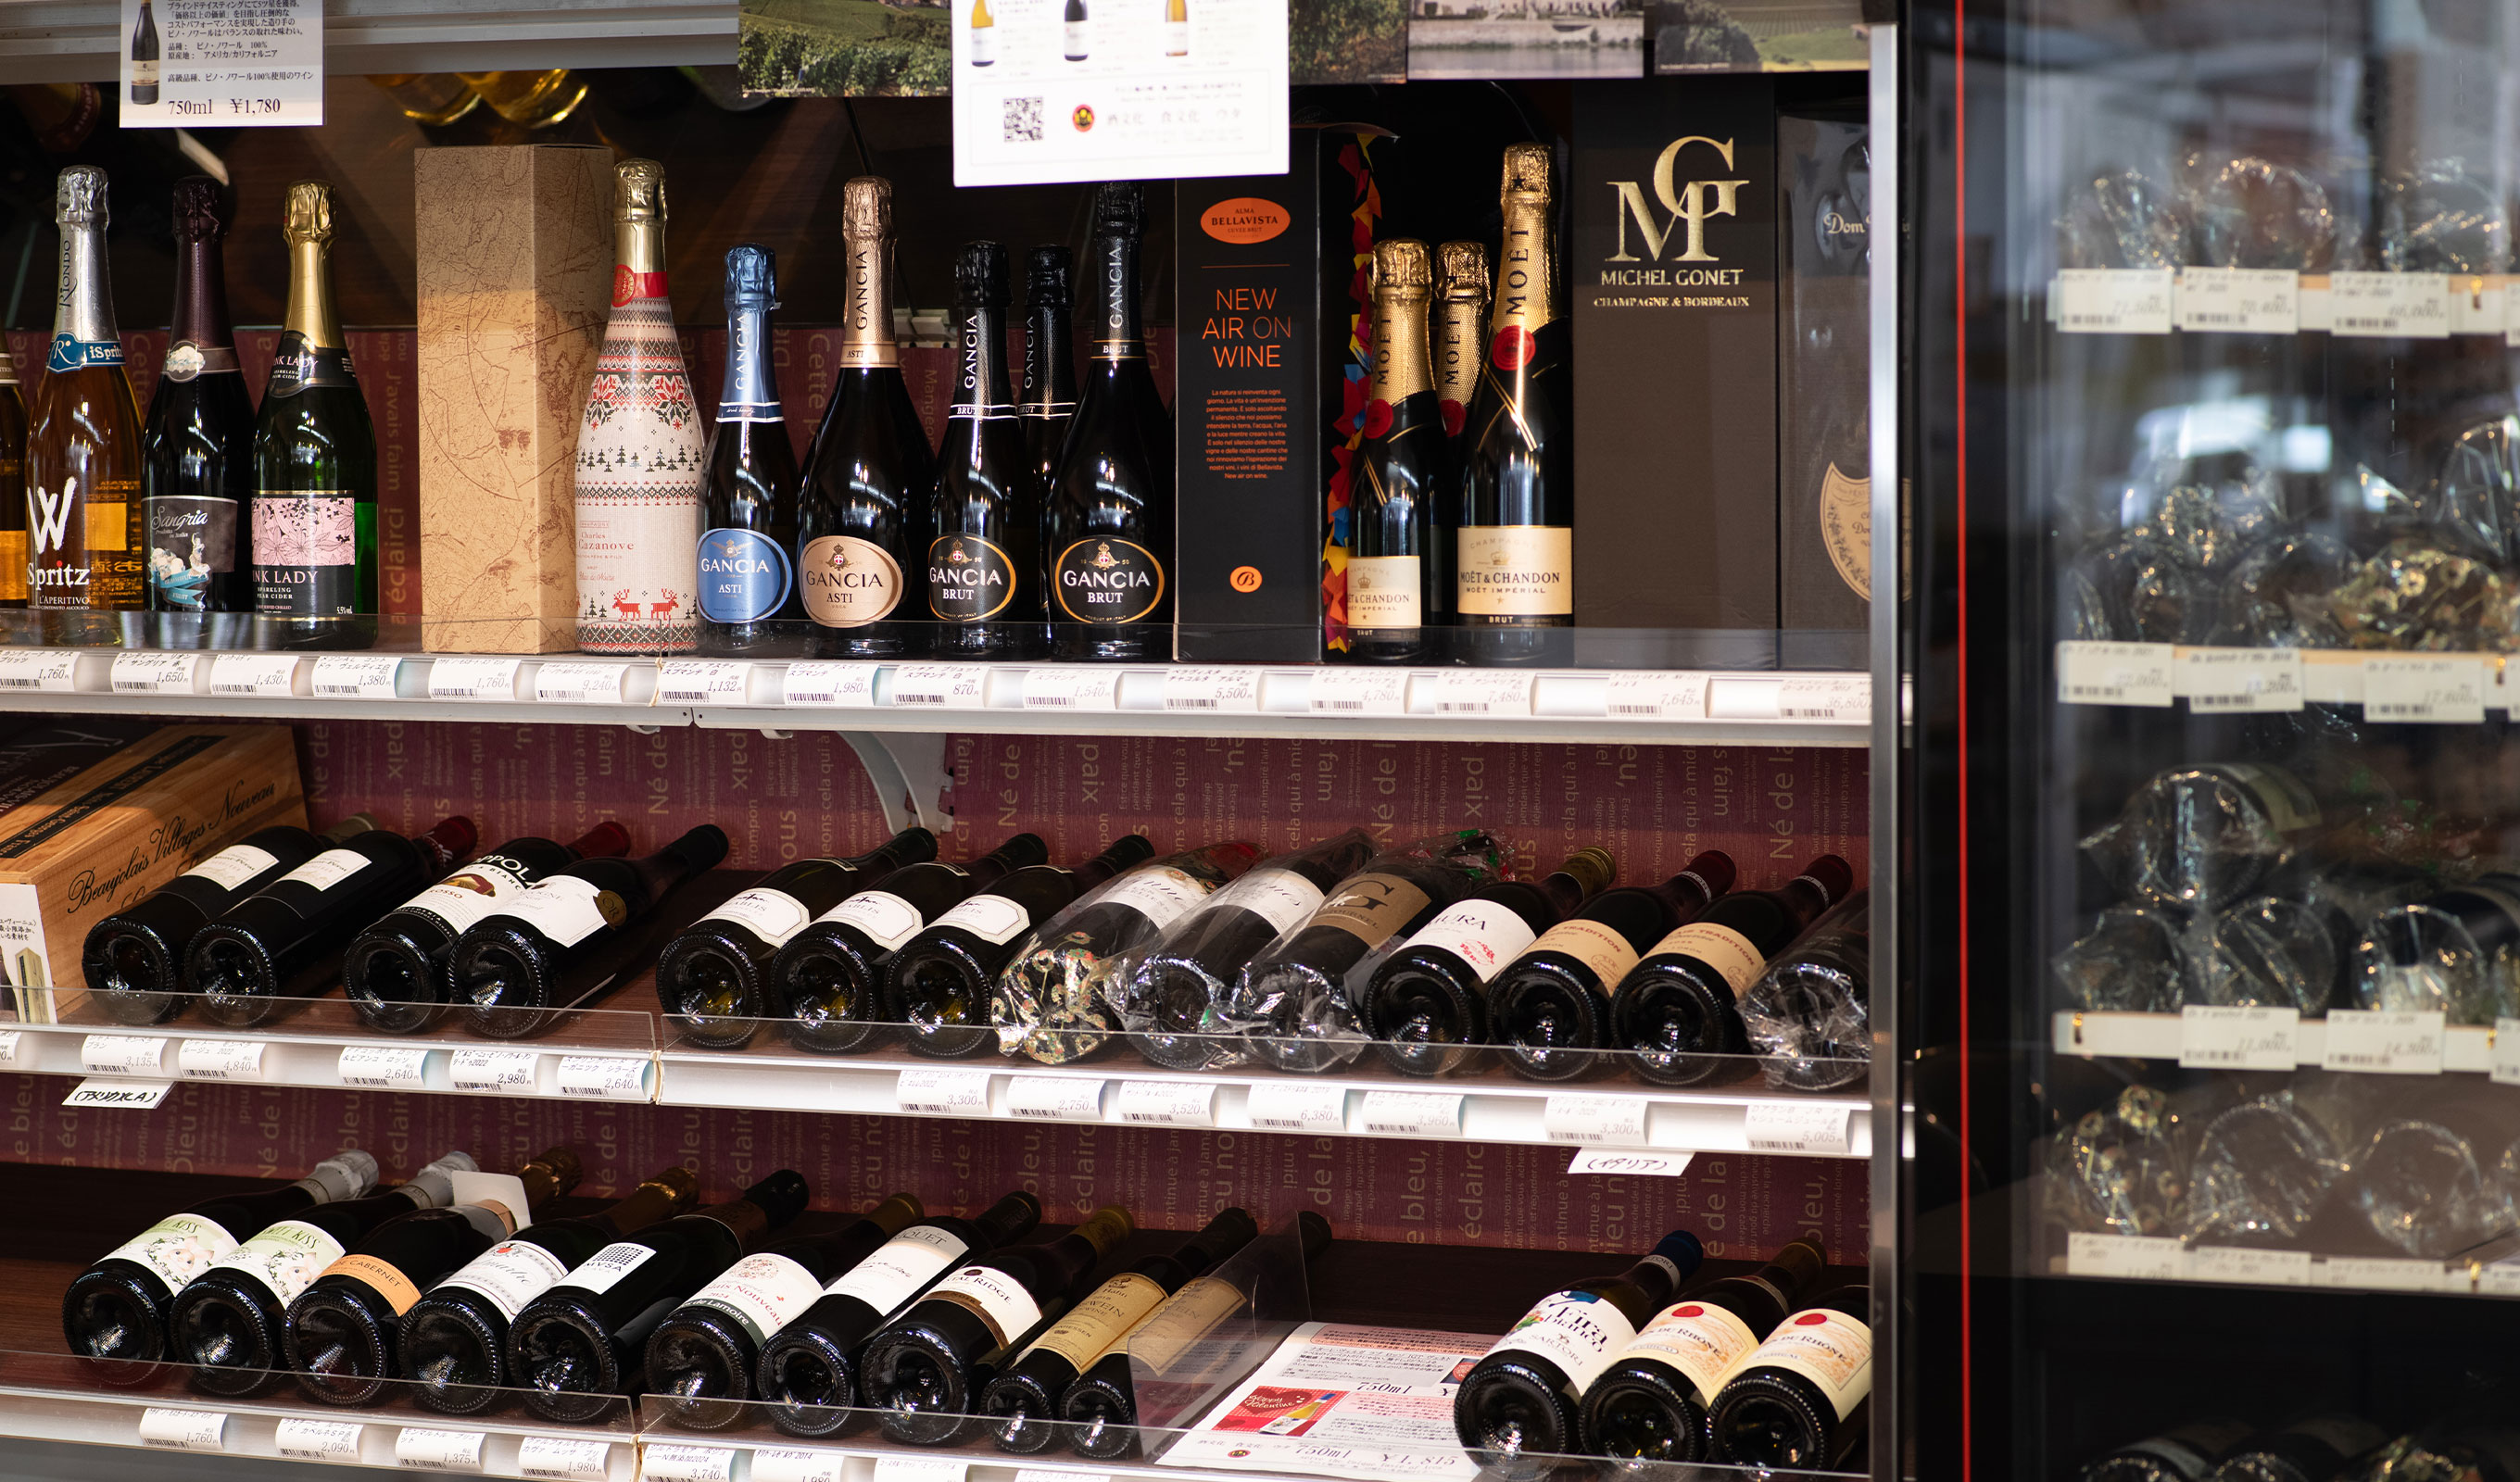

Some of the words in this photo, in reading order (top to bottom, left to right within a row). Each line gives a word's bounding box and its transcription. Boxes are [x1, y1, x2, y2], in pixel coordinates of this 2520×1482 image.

[168, 99, 212, 115] 750ml
[230, 98, 281, 115] ¥1,780
[1212, 216, 1278, 225] BELLAVISTA
[1823, 212, 1866, 234] Dom
[1109, 247, 1121, 328] GANCIA
[1601, 270, 1671, 285] MICHEL
[1675, 269, 1744, 285] GONET
[855, 250, 867, 330] GANCIA
[1216, 288, 1278, 310] NEW
[1594, 297, 1669, 307] CHAMPAGNE
[1671, 297, 1681, 307] &
[1684, 296, 1750, 307] BORDEAUX
[1202, 317, 1244, 340] AIR
[1253, 316, 1292, 339] ON
[90, 344, 123, 361] iSpritz
[847, 349, 864, 358] ASTI
[964, 315, 977, 389] GANCIA
[1025, 317, 1033, 389] GANCIA
[1102, 345, 1128, 354] BRUT
[1213, 345, 1281, 368] WINE
[286, 356, 319, 368] LADY
[386, 372, 402, 439] J'avais
[957, 407, 978, 415] BRUT
[27, 476, 77, 555] W
[151, 506, 208, 531] Sangria
[578, 539, 635, 550] Cazanove
[274, 571, 318, 584] LADY
[701, 559, 769, 572] GANCIA
[929, 566, 1003, 586] GANCIA
[719, 584, 741, 593] ASTI
[806, 571, 883, 588] GANCIA
[1064, 571, 1151, 588] GANCIA
[1484, 574, 1490, 583] &
[1493, 572, 1560, 584] CHANDON
[40, 595, 90, 605] L'APERITIVO
[827, 593, 852, 602] ASTI
[942, 589, 974, 600] BRUT
[1088, 592, 1123, 603] BRUT
[1360, 594, 1409, 603] CHANDON
[388, 723, 409, 779] paix
[599, 730, 614, 775] faim
[726, 733, 753, 789] paix
[957, 737, 974, 785] faim
[998, 745, 1019, 780] de
[1077, 743, 1105, 803] paix
[1317, 752, 1338, 801] faim
[1371, 759, 1396, 795] de
[1461, 756, 1489, 818] paix
[1714, 766, 1732, 816] faim
[1769, 772, 1794, 810] de
[998, 788, 1019, 827] Né
[1371, 807, 1396, 844] Né
[68, 847, 149, 913] Beaujolais
[149, 816, 206, 863] Villages
[208, 780, 275, 829] Nouveau
[1769, 821, 1794, 860] Né
[429, 888, 463, 899] ROSSO
[602, 897, 621, 918] OR
[1563, 925, 1621, 953] TRADITION
[1699, 928, 1756, 966] TRADITION
[1702, 1161, 1726, 1184] la
[1307, 1169, 1332, 1204] de
[1701, 1194, 1725, 1231] de
[172, 1220, 201, 1234] KISS
[292, 1230, 321, 1250] KISS
[350, 1259, 401, 1288] CABERNET
[974, 1277, 1012, 1303] RIDGE
[708, 1300, 750, 1325] Lamoire
[734, 1285, 783, 1326] Nouveau
[1544, 1314, 1602, 1353] bianco
[1556, 1307, 1607, 1345] Fira
[1530, 1334, 1583, 1367] SARTORI
[1249, 1393, 1283, 1404] Happy
[1356, 1381, 1412, 1395] 750ml
[1294, 1446, 1352, 1460] 750ml
